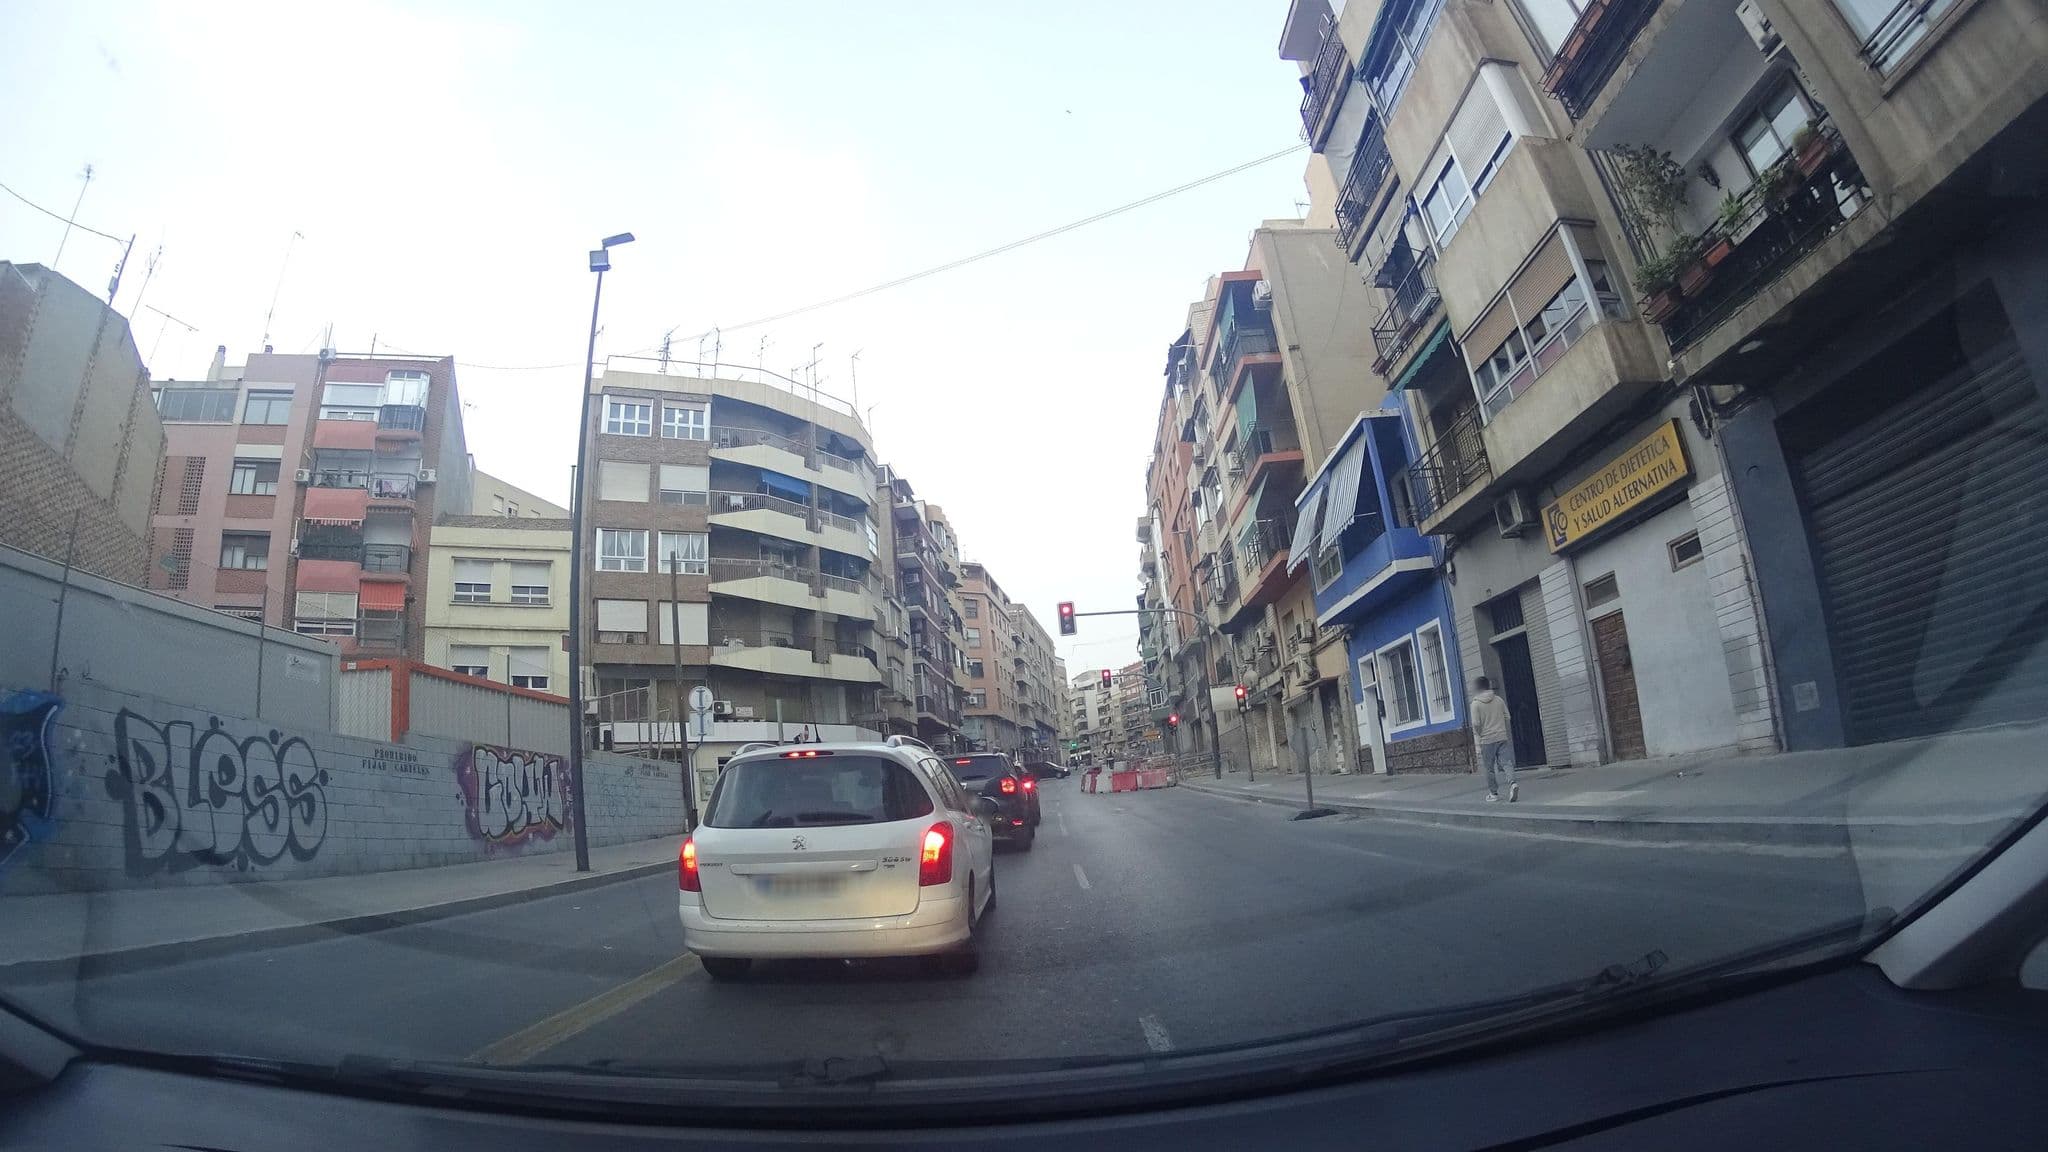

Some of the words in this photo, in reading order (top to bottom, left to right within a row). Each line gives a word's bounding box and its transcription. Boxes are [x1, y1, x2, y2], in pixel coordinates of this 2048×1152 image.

[1569, 478, 1605, 512] CENTRO
[1605, 469, 1620, 489] DE
[1573, 517, 1581, 532] Y
[1581, 499, 1612, 529] SALUD
[1612, 457, 1678, 510] ALTERNATIVA
